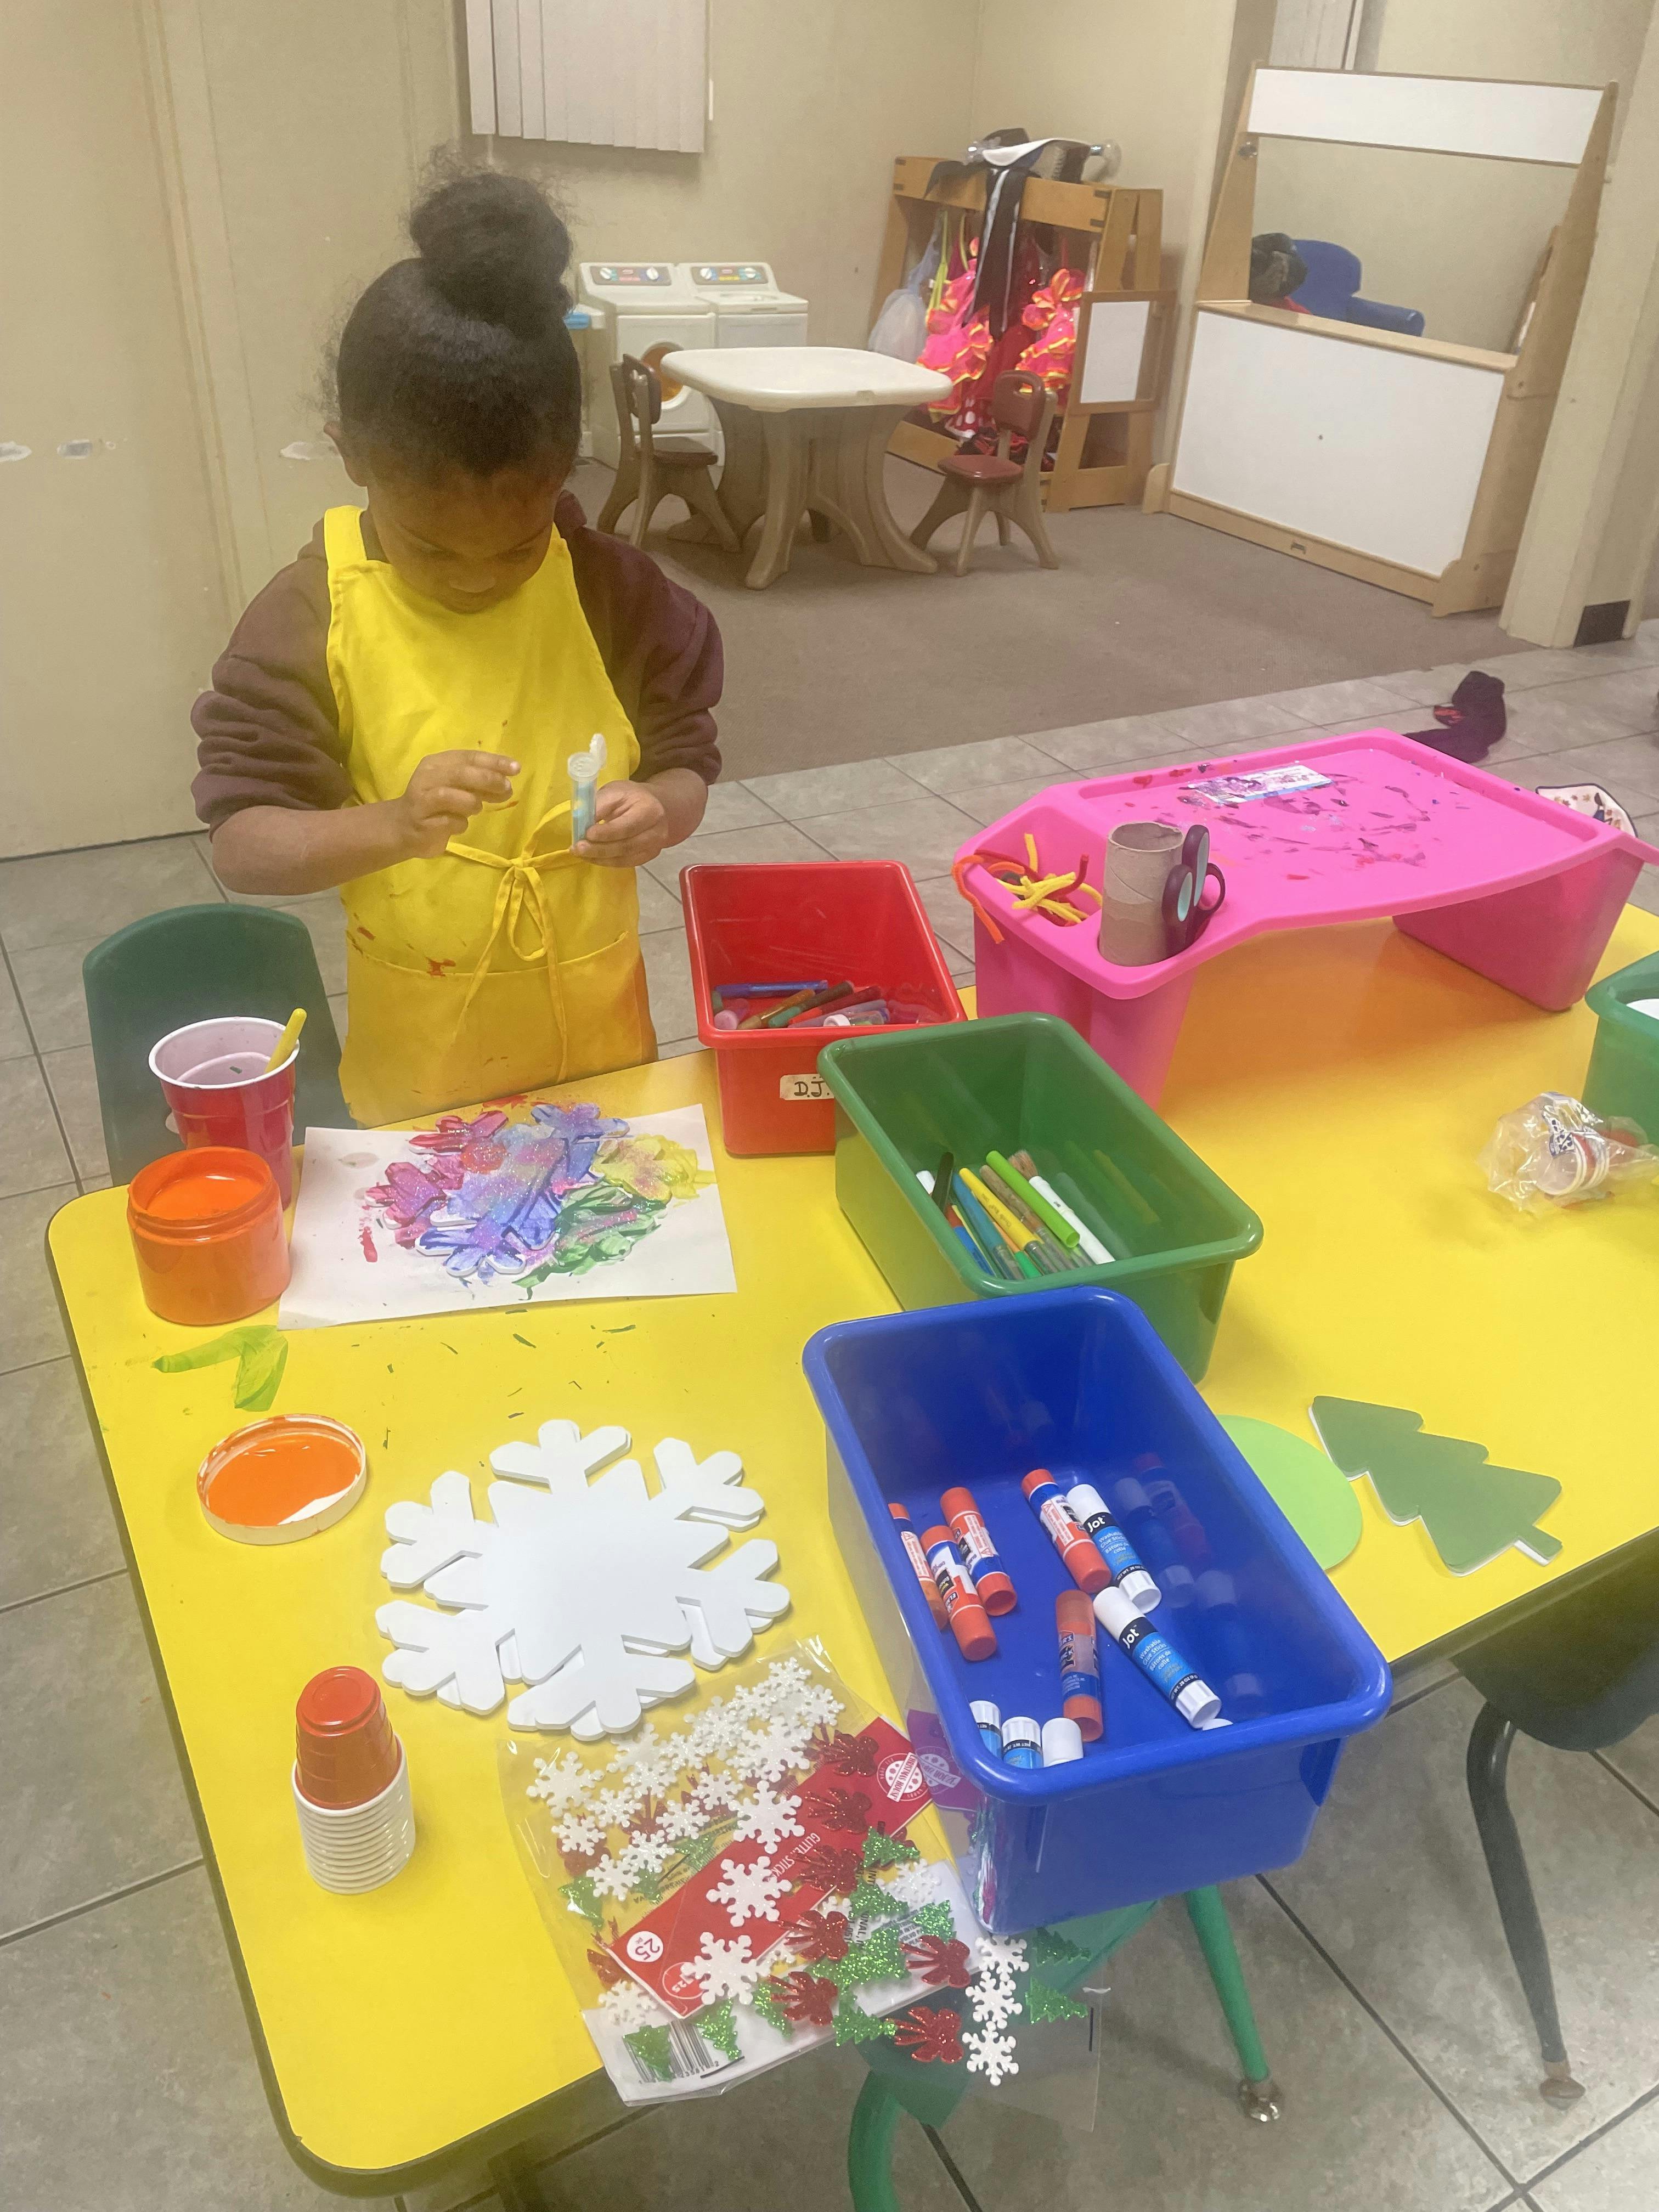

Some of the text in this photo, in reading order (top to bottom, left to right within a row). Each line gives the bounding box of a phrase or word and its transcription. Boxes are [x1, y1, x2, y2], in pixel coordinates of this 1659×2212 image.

[1087, 1515, 1105, 1533] Jot
[1122, 1628, 1139, 1649] Jot
[899, 1754, 917, 1781] CHRISTMAS
[890, 1780, 904, 1800] HOUSE
[790, 1833, 820, 1854] GLITTE
[635, 1938, 660, 1960] 25
